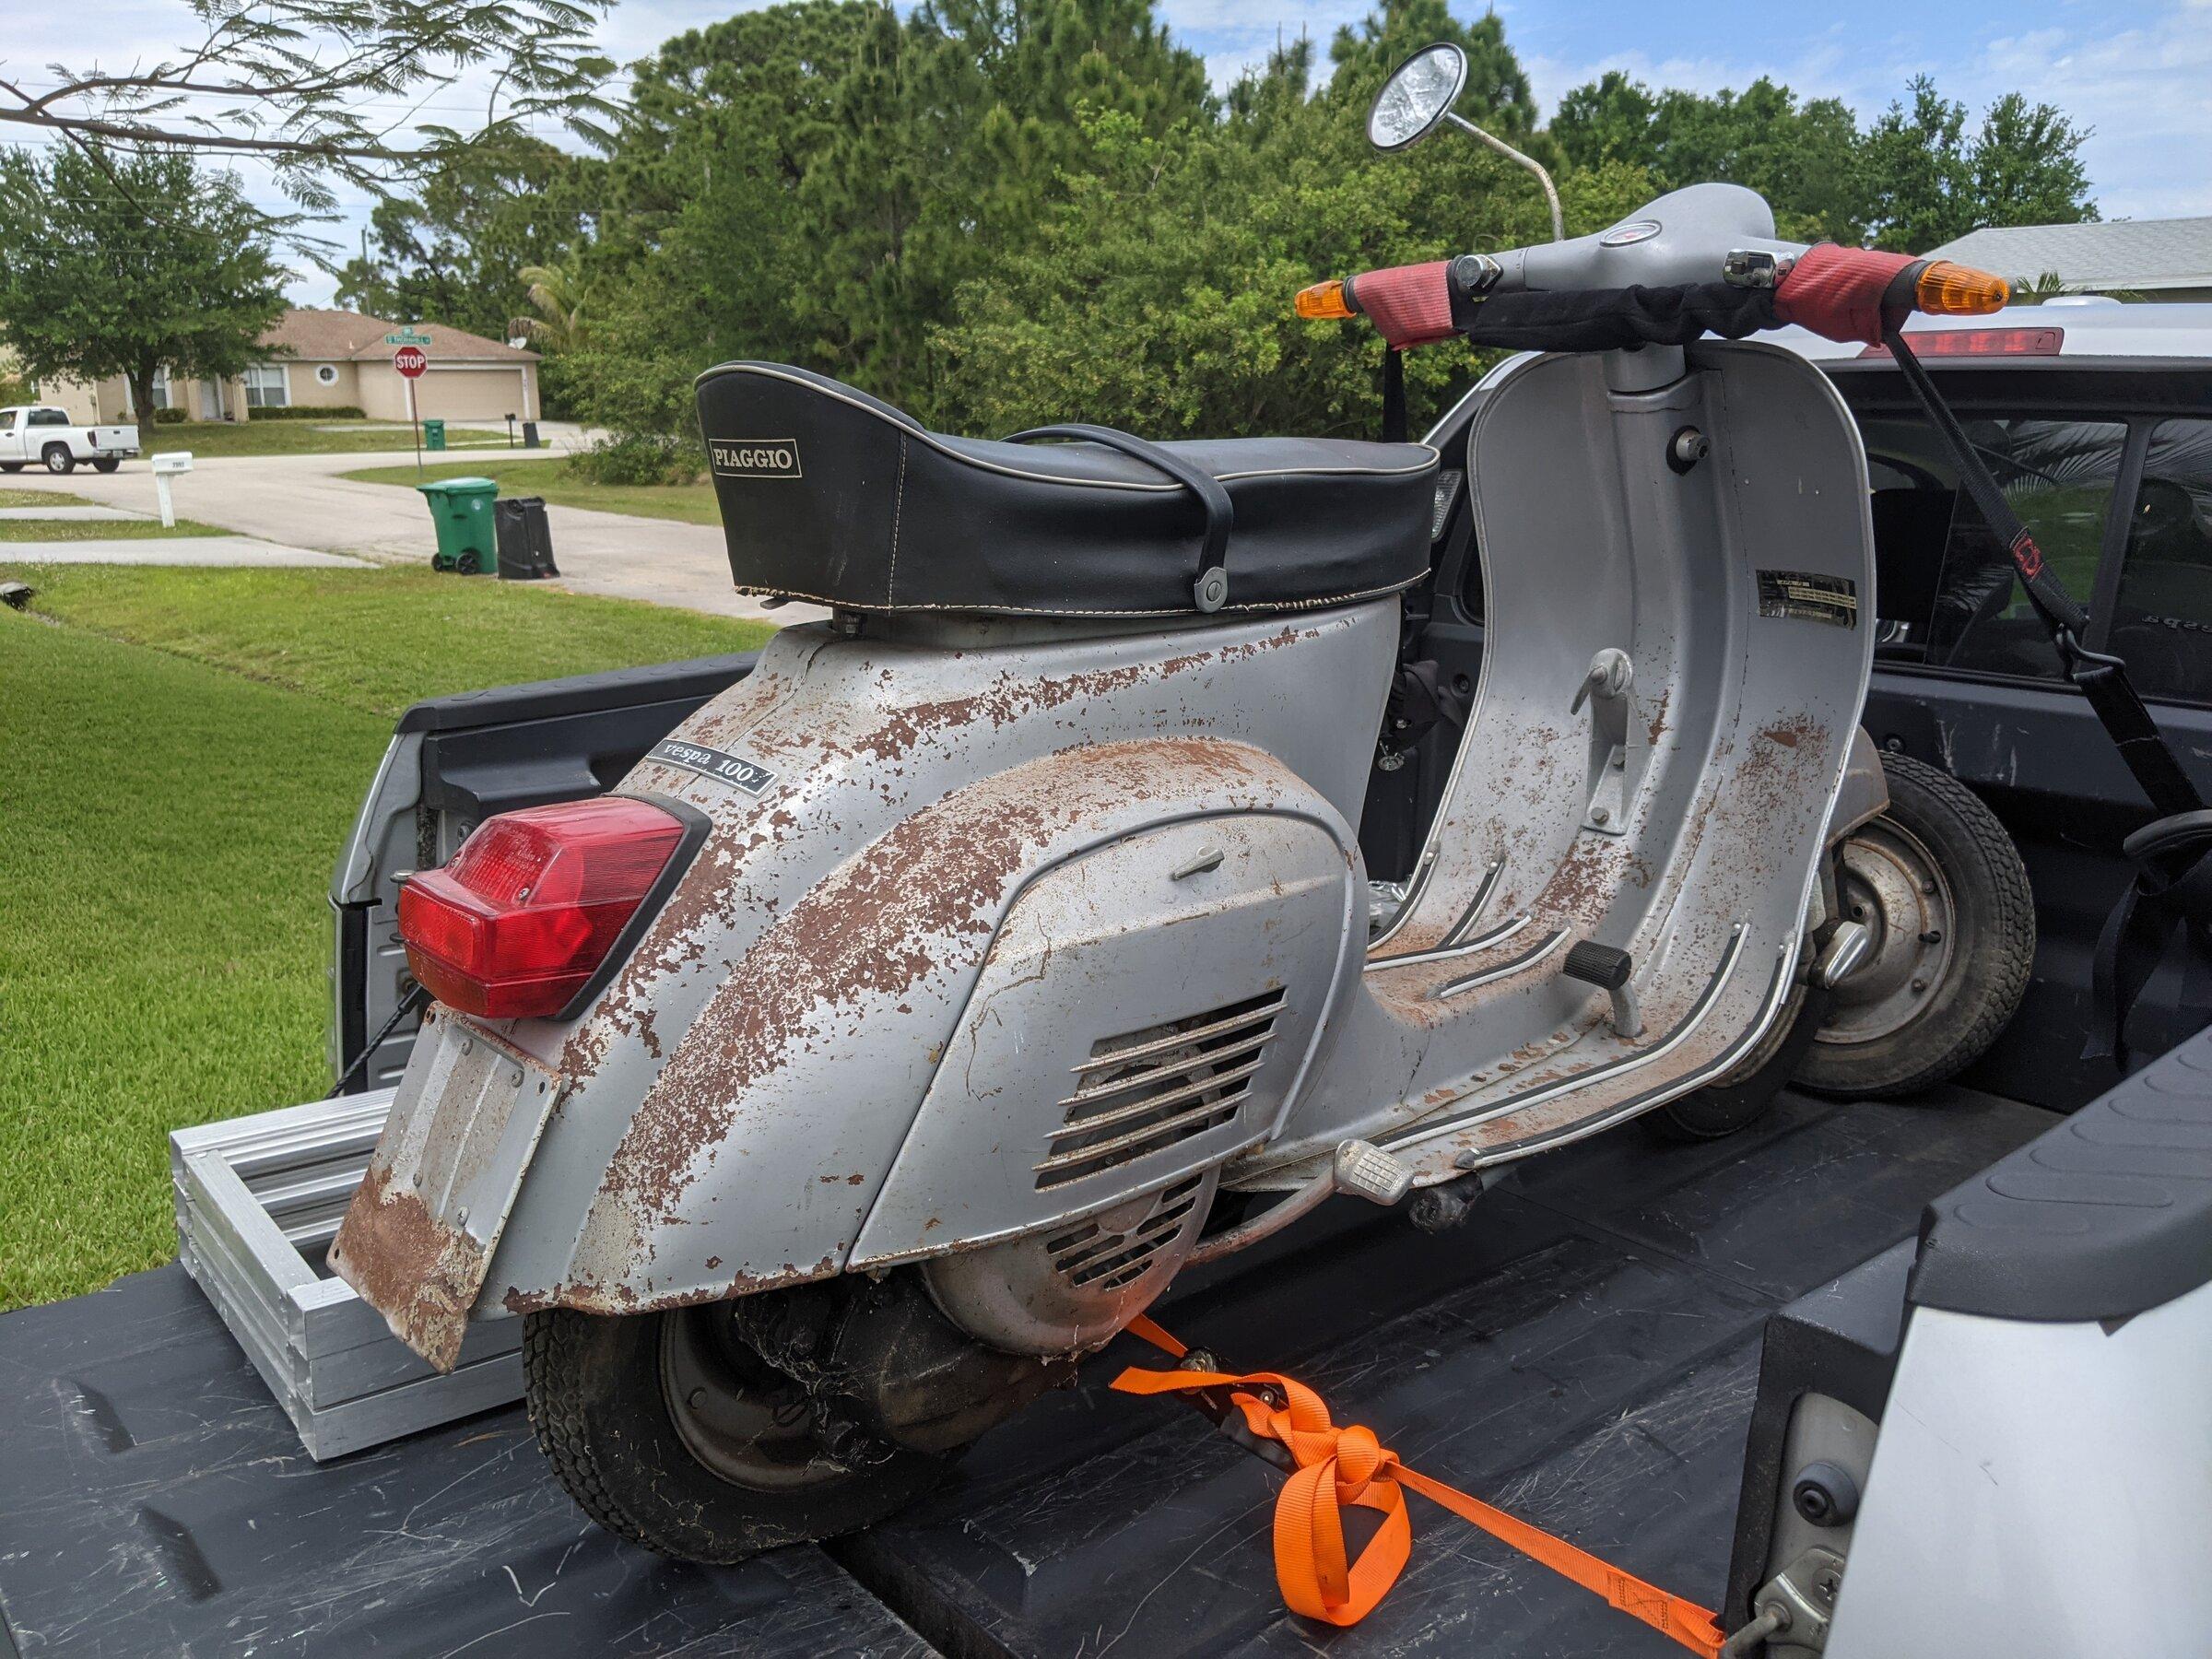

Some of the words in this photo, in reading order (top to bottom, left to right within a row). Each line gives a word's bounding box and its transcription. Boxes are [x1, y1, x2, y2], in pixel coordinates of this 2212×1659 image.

[396, 355, 425, 369] STOP
[713, 448, 793, 469] PIAGGIO
[715, 759, 754, 782] 100
